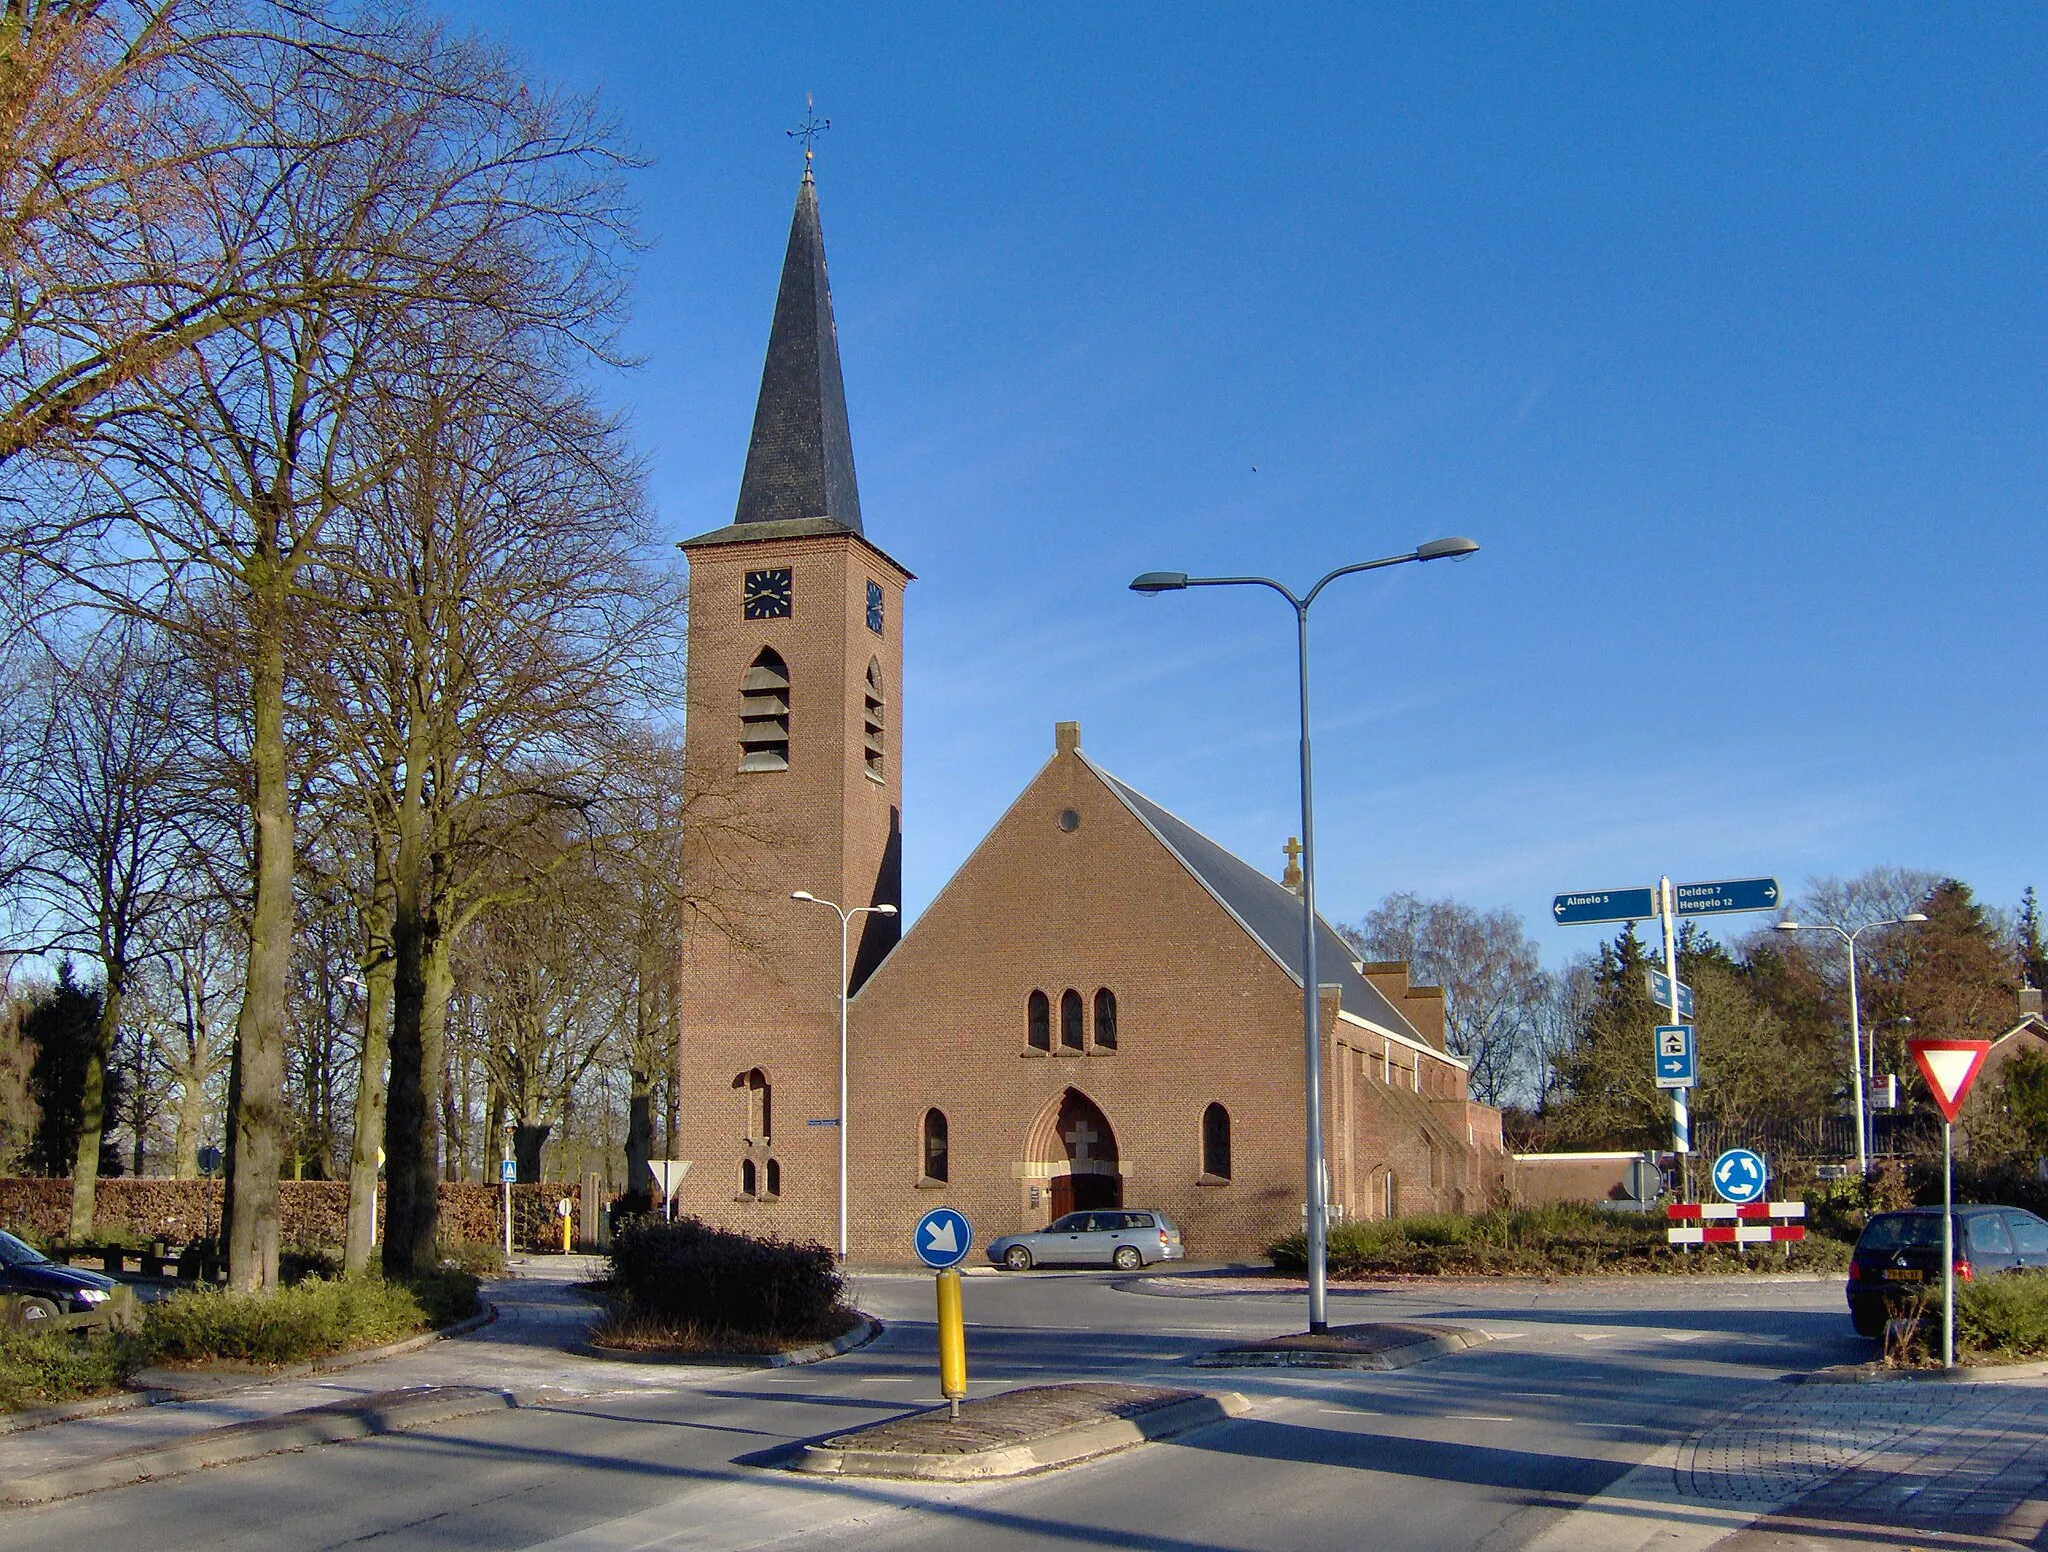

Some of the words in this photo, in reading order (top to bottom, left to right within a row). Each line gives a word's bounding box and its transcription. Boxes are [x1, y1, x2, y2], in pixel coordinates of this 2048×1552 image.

[1680, 888, 1714, 897] Delden
[1567, 896, 1601, 906] Almelo
[1603, 895, 1609, 903] 5
[1680, 899, 1720, 910] Hengelo
[1723, 898, 1733, 906] 12
